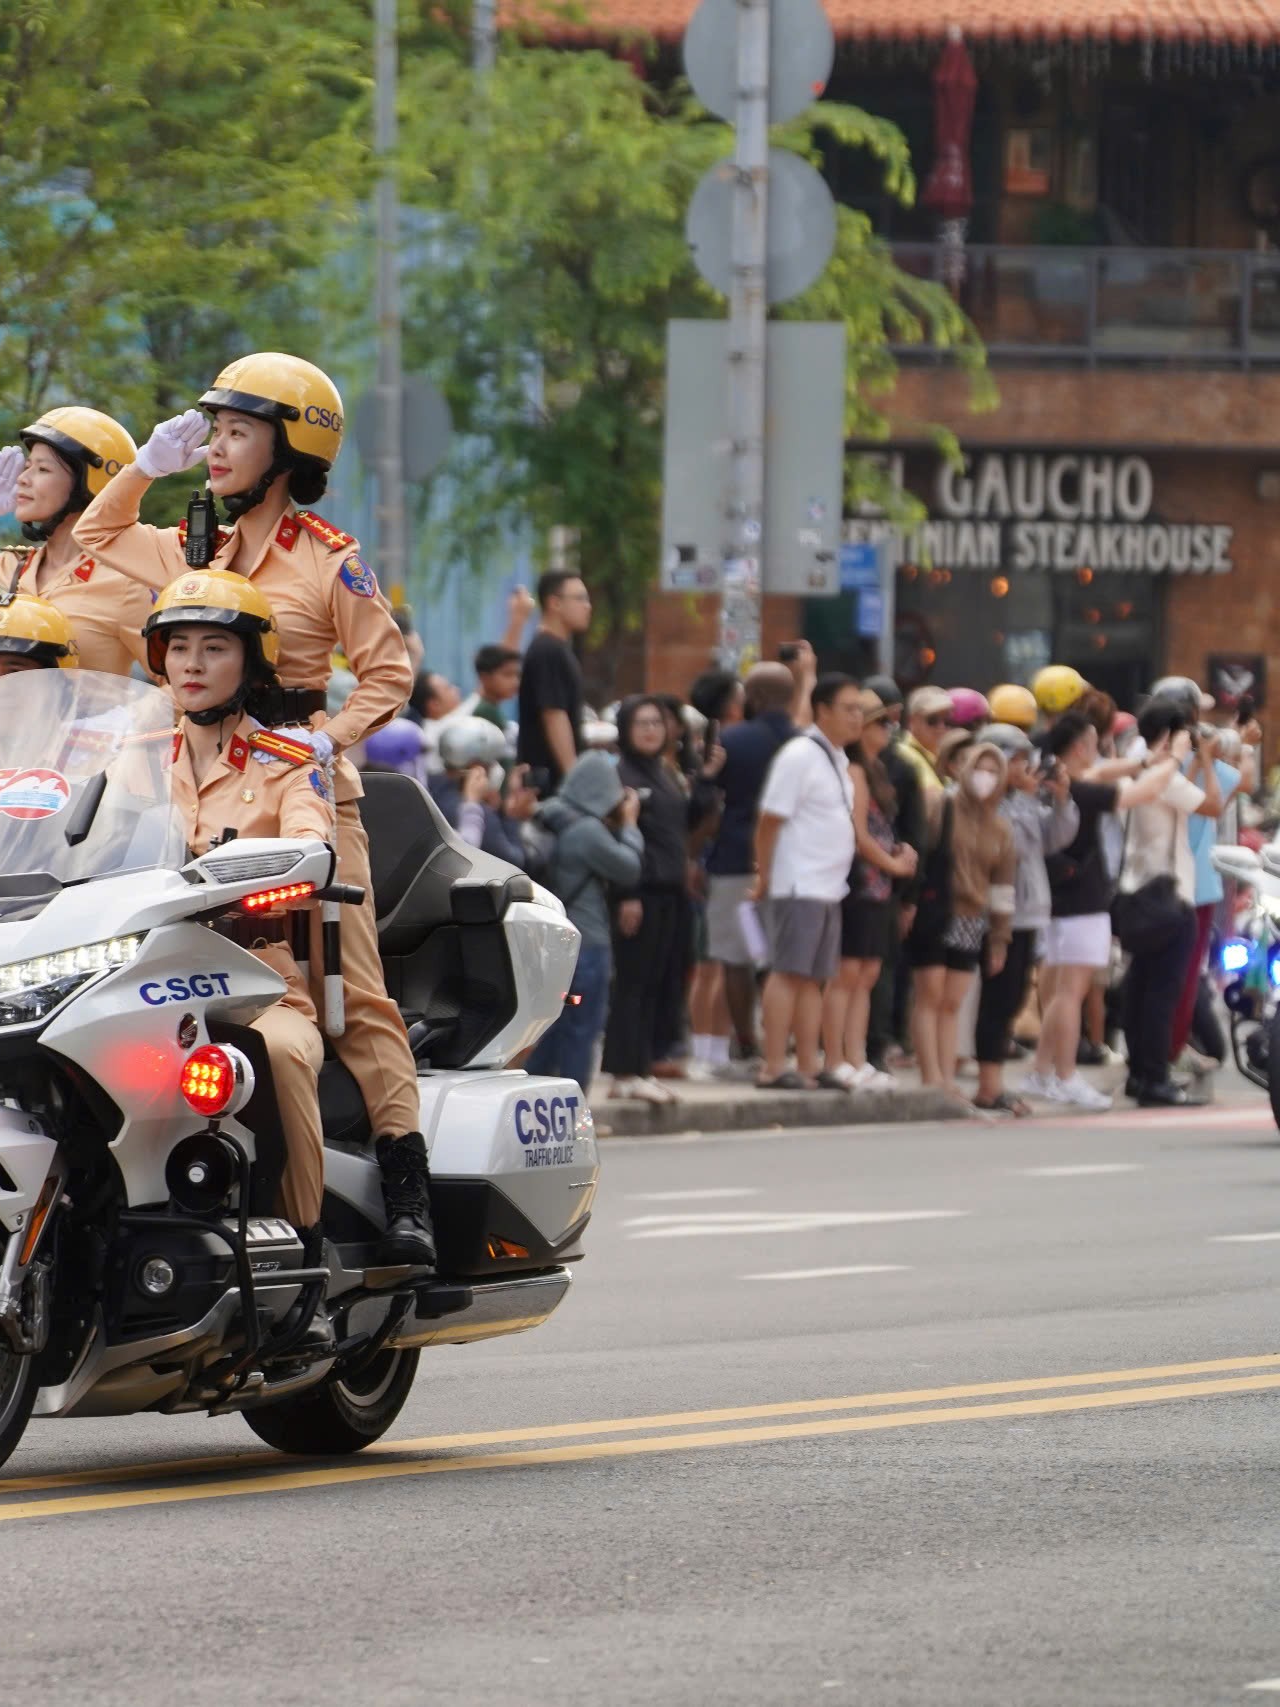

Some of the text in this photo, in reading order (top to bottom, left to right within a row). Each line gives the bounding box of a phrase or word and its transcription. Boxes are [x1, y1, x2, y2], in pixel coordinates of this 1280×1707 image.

[938, 453, 1153, 521] GAUCHO
[1015, 521, 1233, 572] STEAKHOUSE
[525, 1146, 574, 1168] TRAFFIC POLICE
